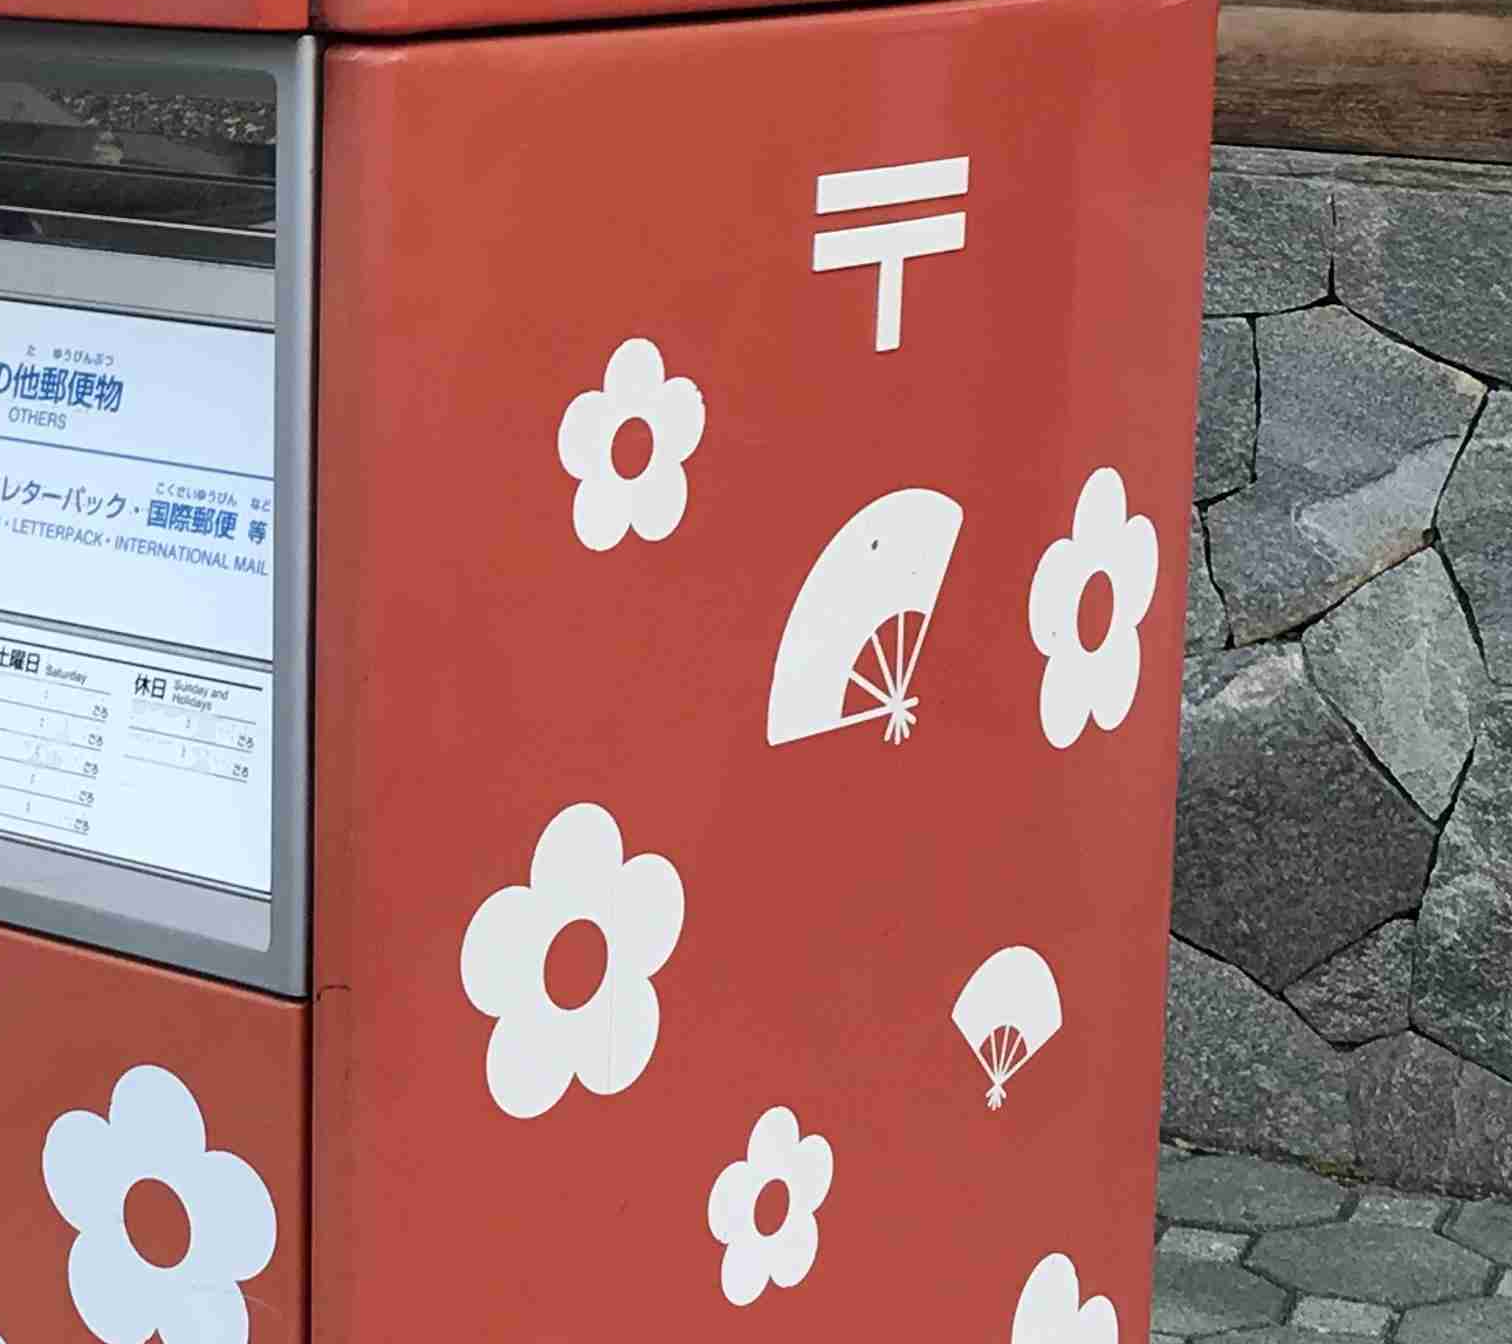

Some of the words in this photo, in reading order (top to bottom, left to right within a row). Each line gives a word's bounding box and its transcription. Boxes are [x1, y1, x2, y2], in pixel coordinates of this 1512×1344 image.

[8, 405, 67, 430] OTHERS
[11, 515, 104, 547] LETTERPACK
[114, 535, 229, 571] INTERNATIONAL
[234, 556, 269, 576] MAIL
[134, 672, 167, 700] 休日
